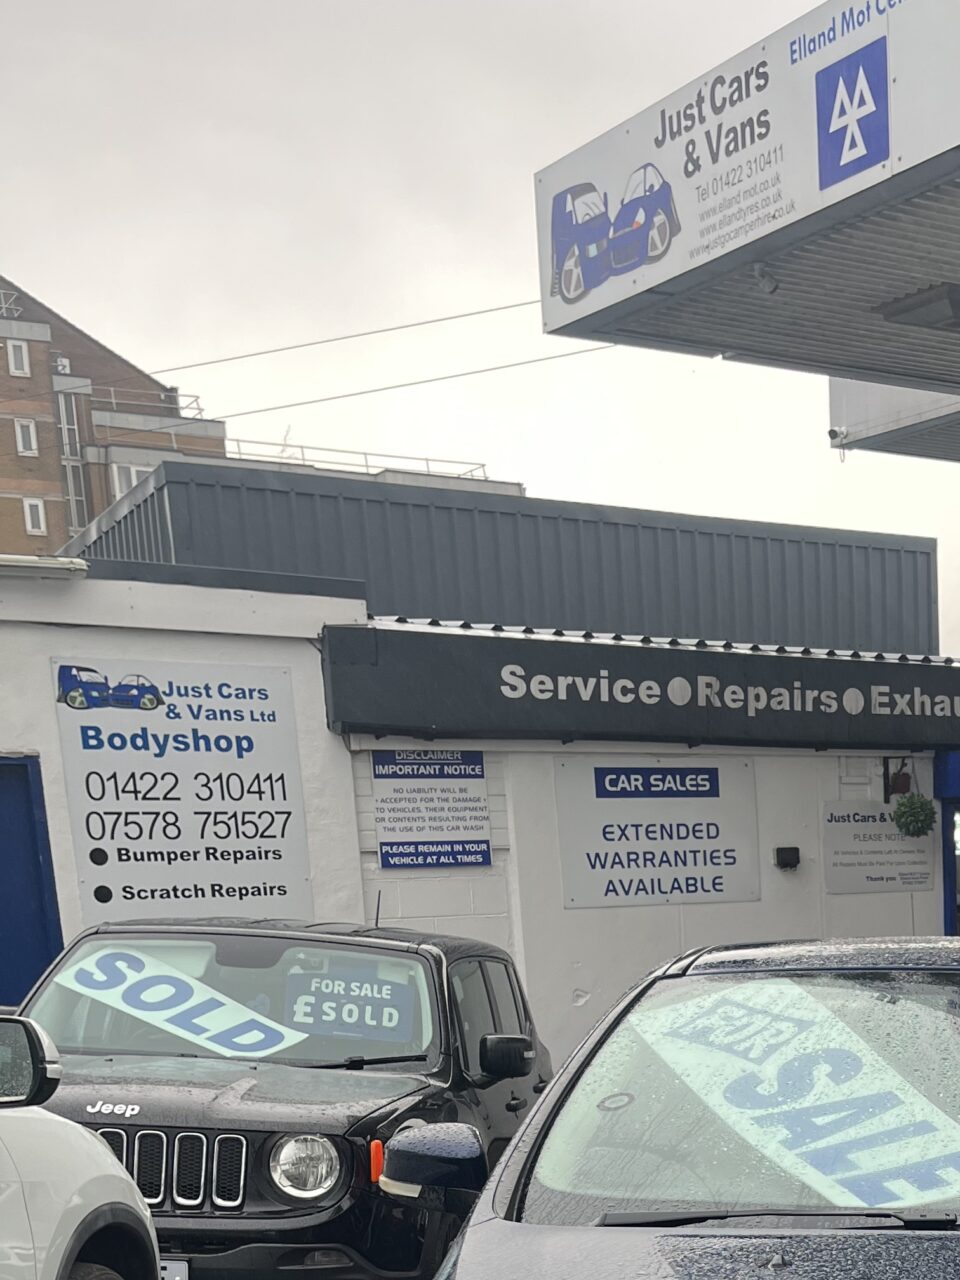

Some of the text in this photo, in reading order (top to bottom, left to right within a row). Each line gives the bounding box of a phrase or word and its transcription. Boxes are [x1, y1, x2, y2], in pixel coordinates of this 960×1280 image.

[789, 16, 836, 65] Elland
[841, 1, 871, 37] Mot
[654, 60, 770, 148] Just Cars
[683, 108, 771, 178] & Vans
[696, 143, 784, 203] Tel 01422 310411
[699, 188, 784, 238] www.ellandtyres.co.uk
[161, 681, 270, 701] Just Cars
[500, 664, 661, 703] Service
[697, 675, 838, 716] Repairs
[165, 704, 277, 723] & Vans Ltd
[79, 725, 255, 758] Bodyshop
[395, 750, 462, 760] DISCLAIMER
[375, 764, 483, 776] IMPORTANT NOTICE
[85, 771, 288, 801] 01422 310411
[604, 774, 711, 792] CAR SALES
[85, 811, 293, 840] 07578 751527
[375, 816, 386, 824] OR
[827, 812, 851, 823] Just
[852, 812, 877, 823] Cars
[879, 812, 887, 823] &
[601, 822, 720, 842] EXTENDED
[853, 833, 906, 842] PLEASE NOTE
[116, 846, 283, 866] Bumper Repairs
[382, 845, 417, 854] PLEASE
[418, 844, 451, 853] REMAIN
[464, 843, 487, 851] YOUR
[388, 854, 483, 865] VEHICLE AT ALL TIMES
[586, 848, 737, 870] WARRANTIES
[121, 882, 288, 901] Scratch Repairs
[604, 875, 724, 897] AVAILABLE
[311, 978, 392, 999] FOR SALE
[73, 950, 285, 1054] SOLD
[694, 1002, 801, 1060] FOR
[86, 1101, 141, 1118] Jeep
